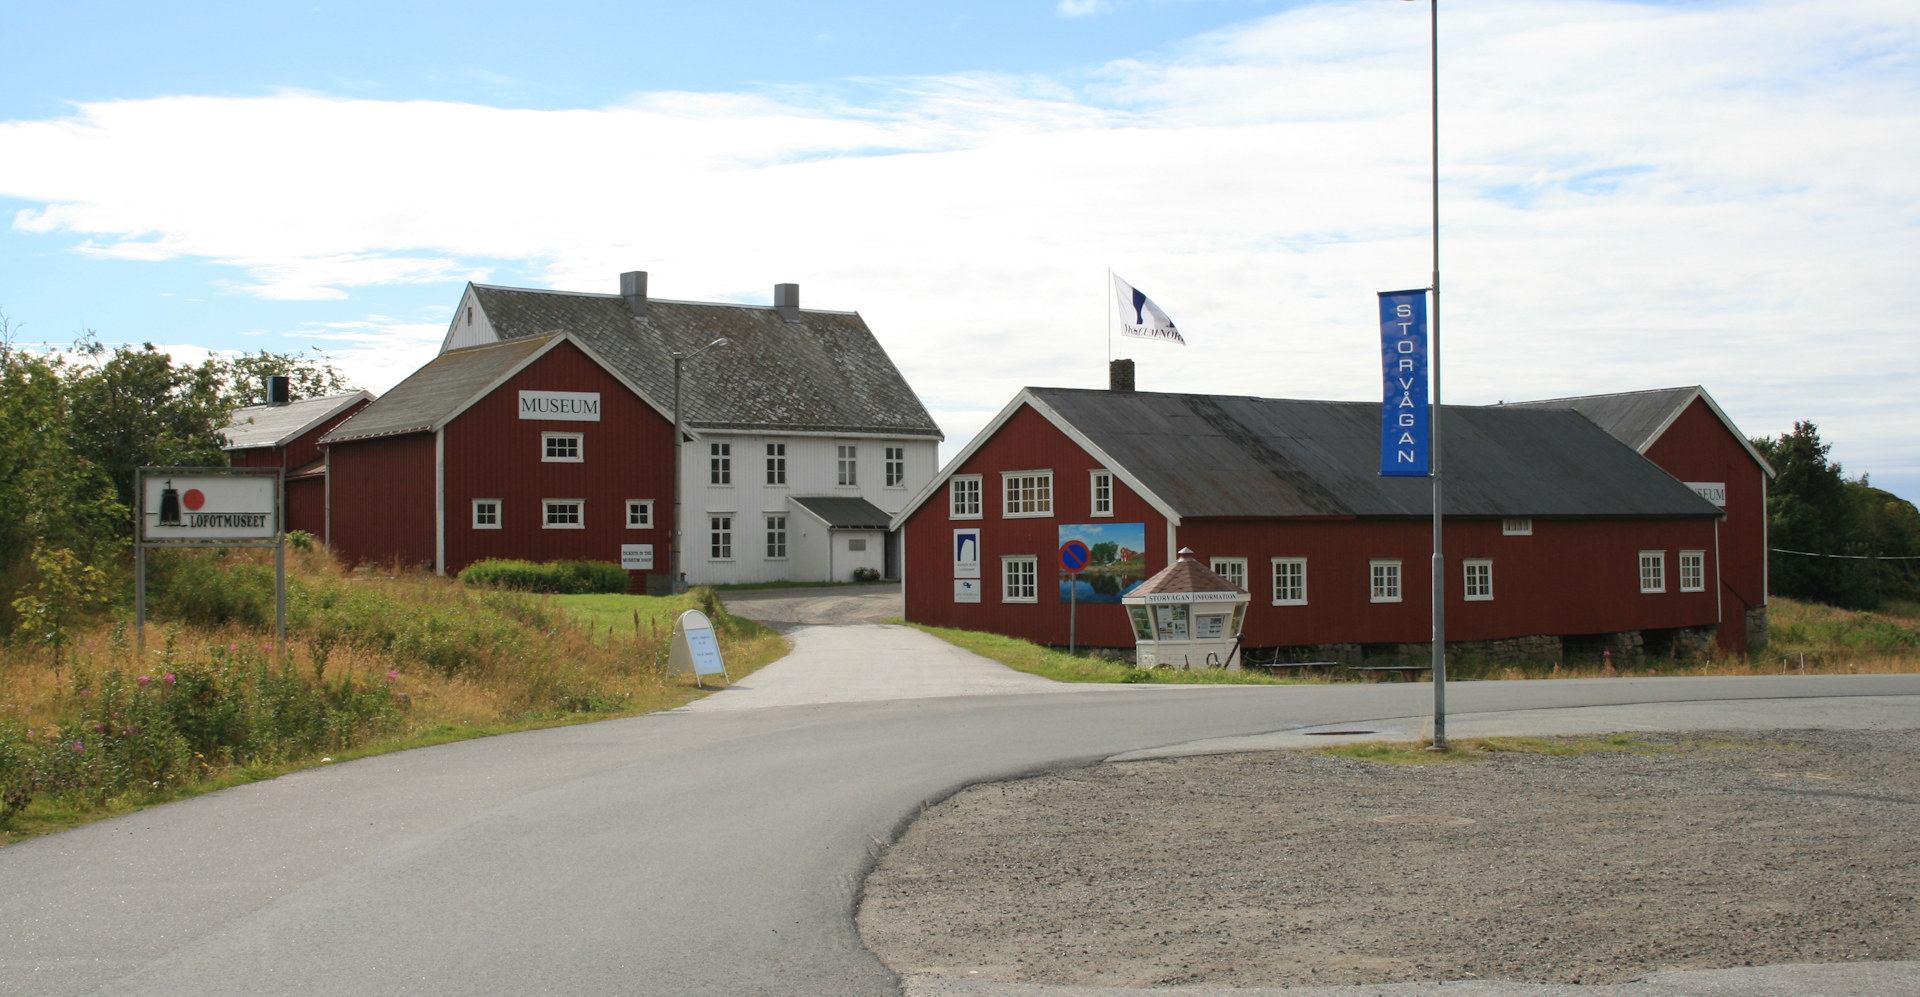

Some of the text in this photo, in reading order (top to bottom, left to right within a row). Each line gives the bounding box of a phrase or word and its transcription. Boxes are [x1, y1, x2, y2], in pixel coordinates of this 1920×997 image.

[1396, 304, 1415, 463] STORVÅGAN
[521, 397, 598, 415] MUSEUM
[1694, 487, 1725, 501] SEUM
[190, 515, 266, 528] LOFOTMUSEET
[1195, 593, 1236, 601] INFORMATION
